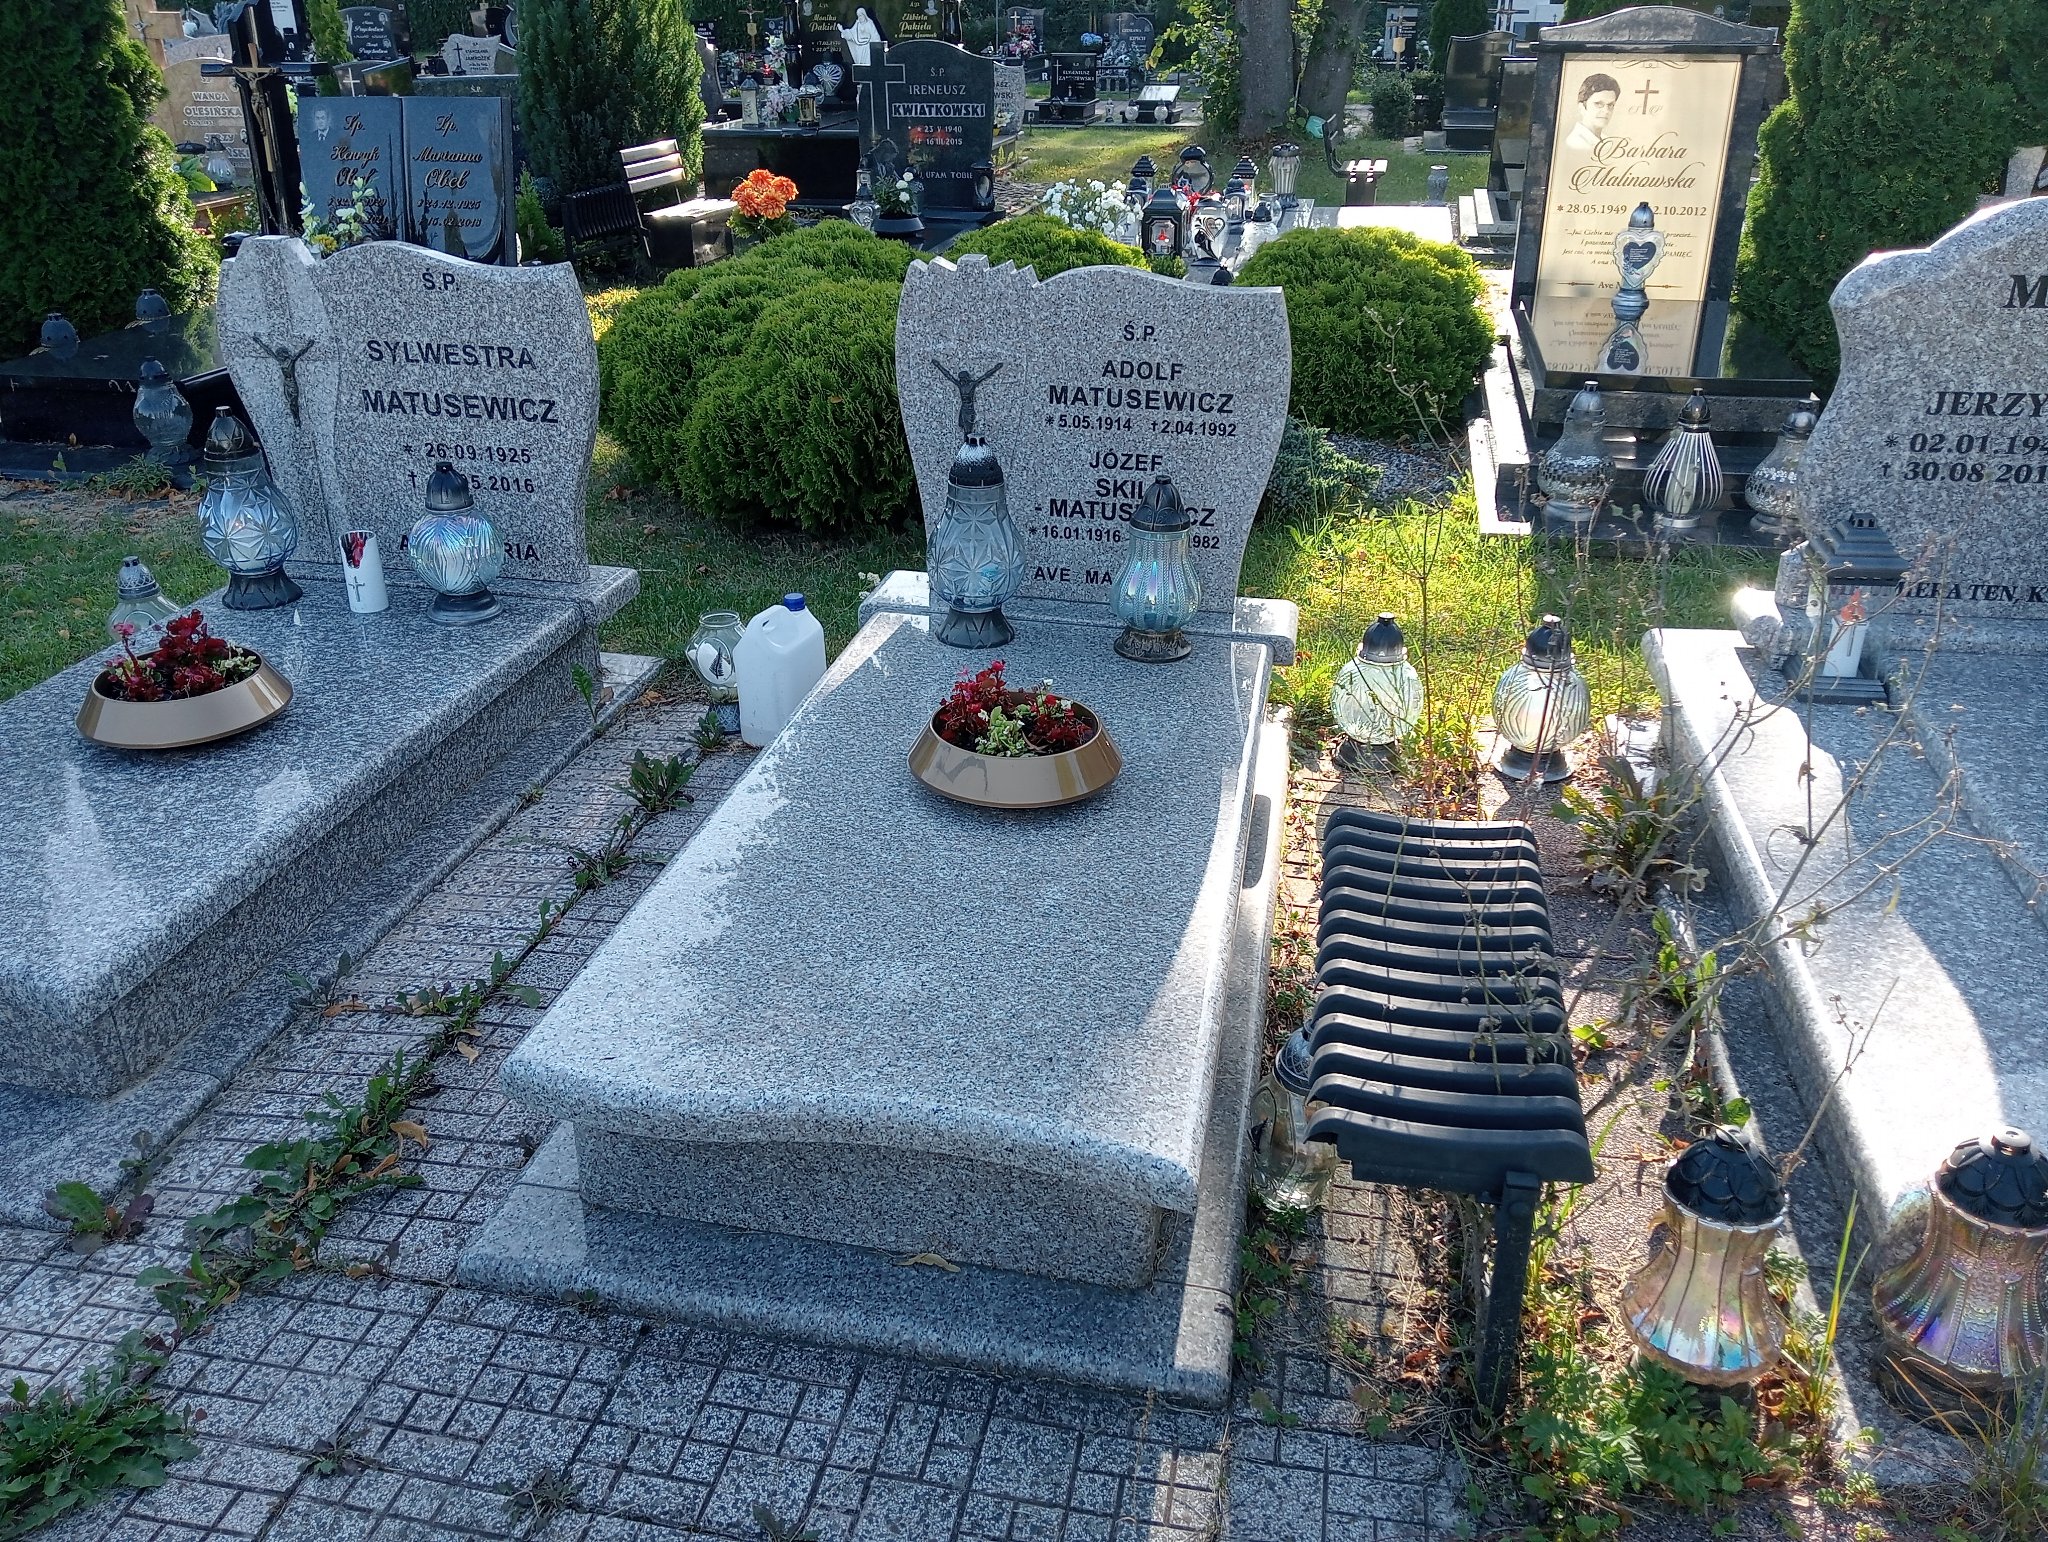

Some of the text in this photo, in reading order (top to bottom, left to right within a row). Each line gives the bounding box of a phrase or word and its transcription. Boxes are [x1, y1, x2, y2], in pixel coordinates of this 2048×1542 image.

[192, 91, 230, 102] WANDA
[908, 84, 967, 95] IRENEUSZ
[183, 106, 243, 118] OLESIŃSKA
[891, 102, 986, 118] KWIATKOWSKI
[330, 145, 380, 168] Henryk
[412, 146, 483, 163] Marianna
[1591, 131, 1688, 165] Barbara
[334, 166, 379, 186] Obl
[424, 168, 470, 189] Obel
[1568, 161, 1706, 194] Malinowska
[1565, 203, 1707, 217] 28.05.1949 2.10.2012
[422, 268, 460, 291] Ś.P.
[1123, 321, 1158, 343] Ś.P.
[366, 339, 537, 370] SYLWESTRA
[1101, 360, 1184, 381] ADOLF
[362, 389, 559, 424] MATUSEWICZ
[1049, 384, 1235, 415] MATUSEWICZ
[1925, 390, 2048, 418] JERZY
[1058, 414, 1237, 438] 5.05.1914 2.04.1992
[425, 442, 532, 464] 26.09.1925
[1089, 448, 1164, 473] JÓZEF
[1049, 499, 1216, 528] MATUSCZ
[1042, 525, 1122, 543] 16.01.1916
[1033, 566, 1071, 582] AVE
